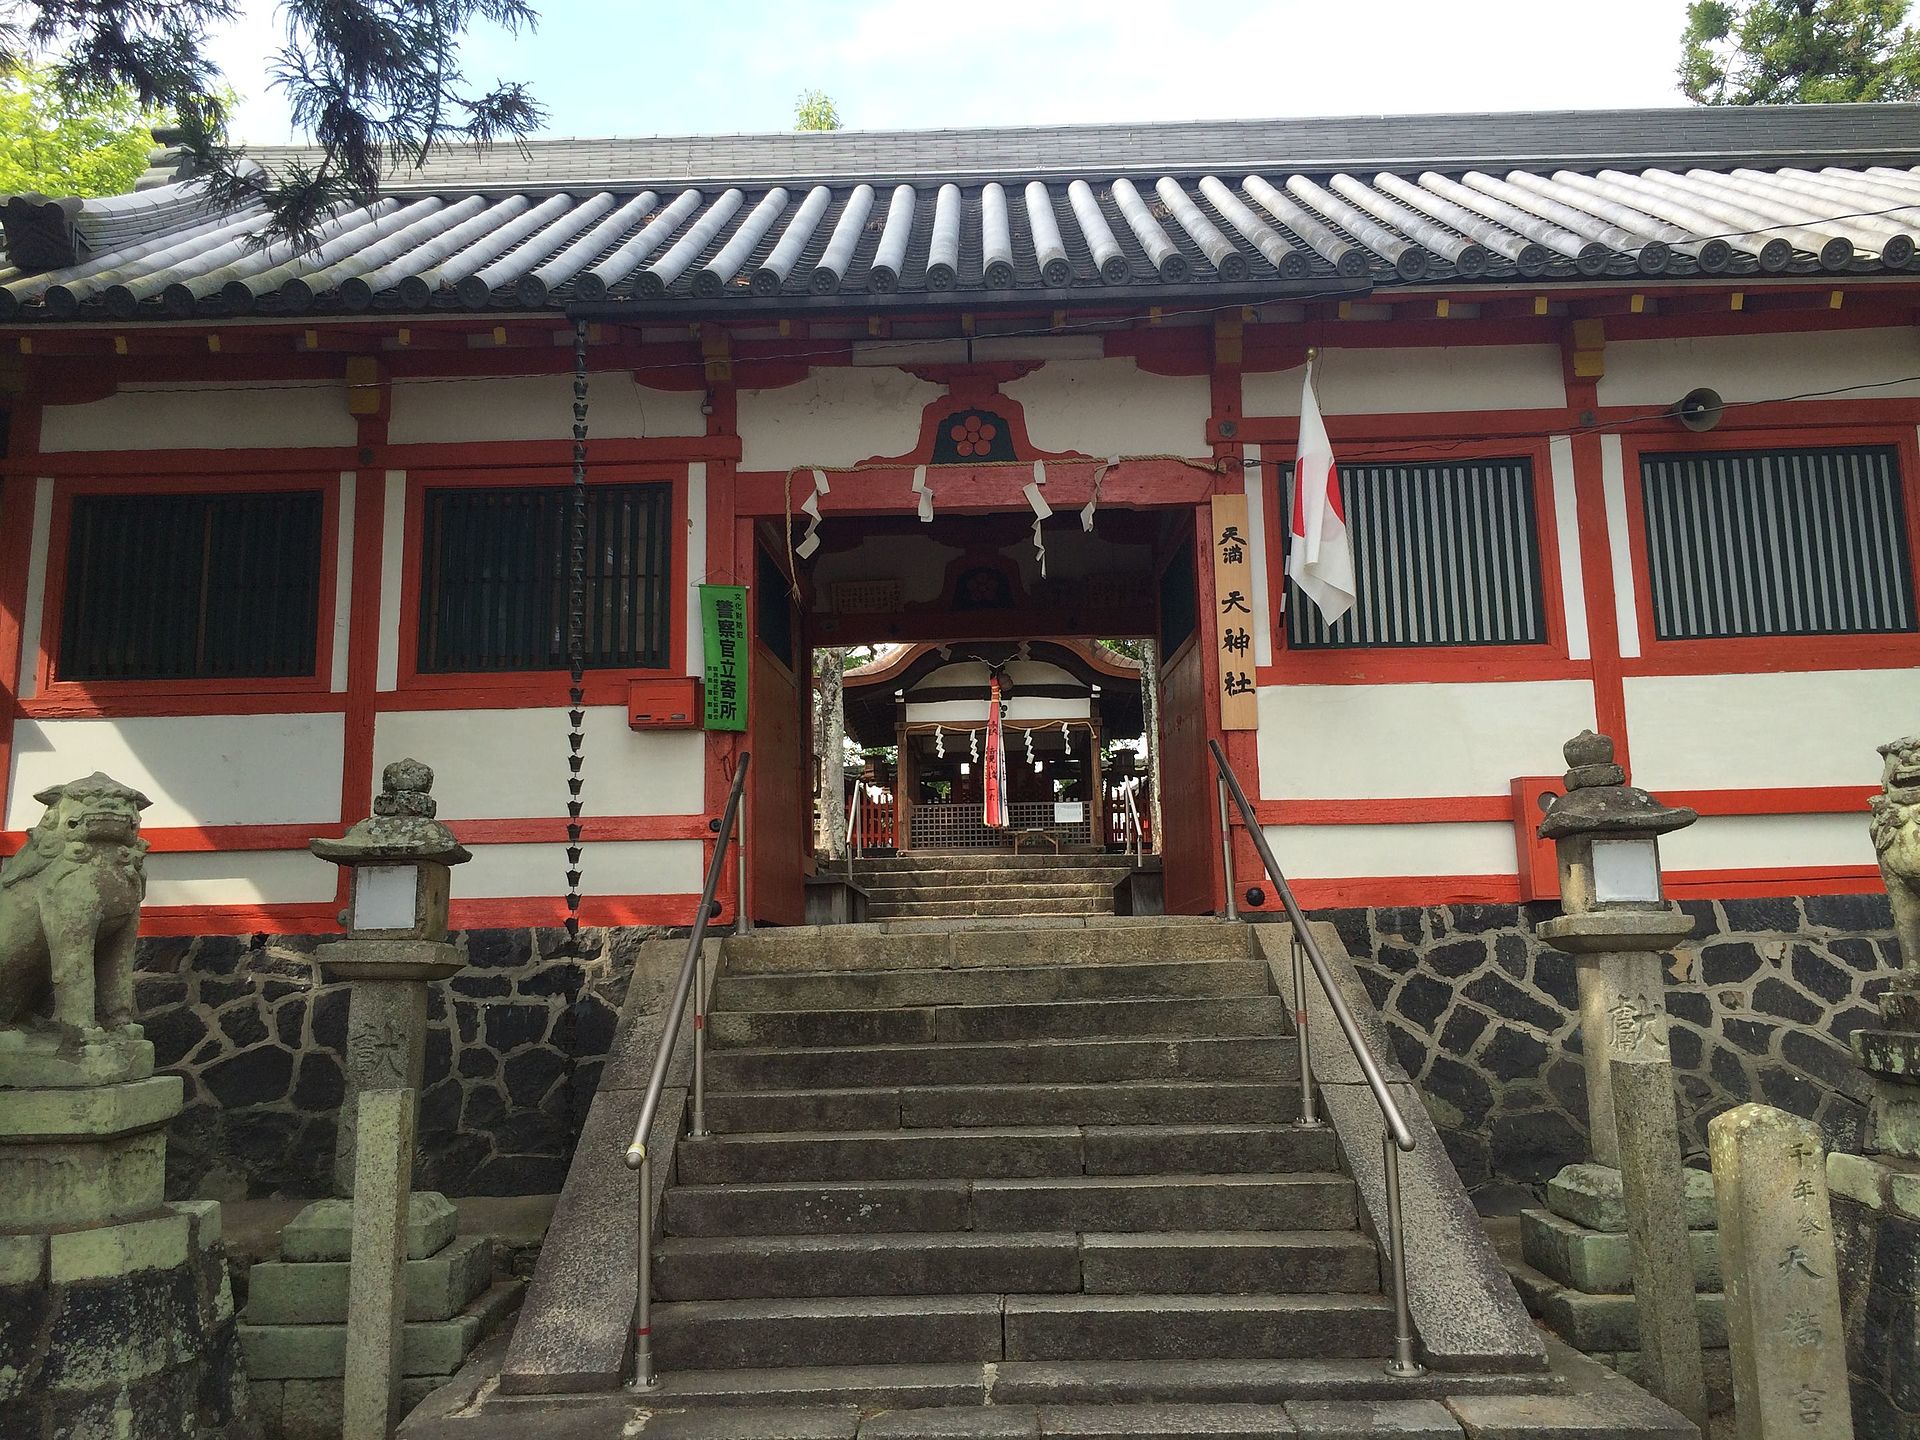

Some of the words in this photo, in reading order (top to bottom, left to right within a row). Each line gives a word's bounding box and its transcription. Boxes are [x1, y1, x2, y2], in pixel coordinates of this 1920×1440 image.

[715, 599, 737, 721] 警察官立寄所
[1218, 526, 1256, 697] 天満天神社
